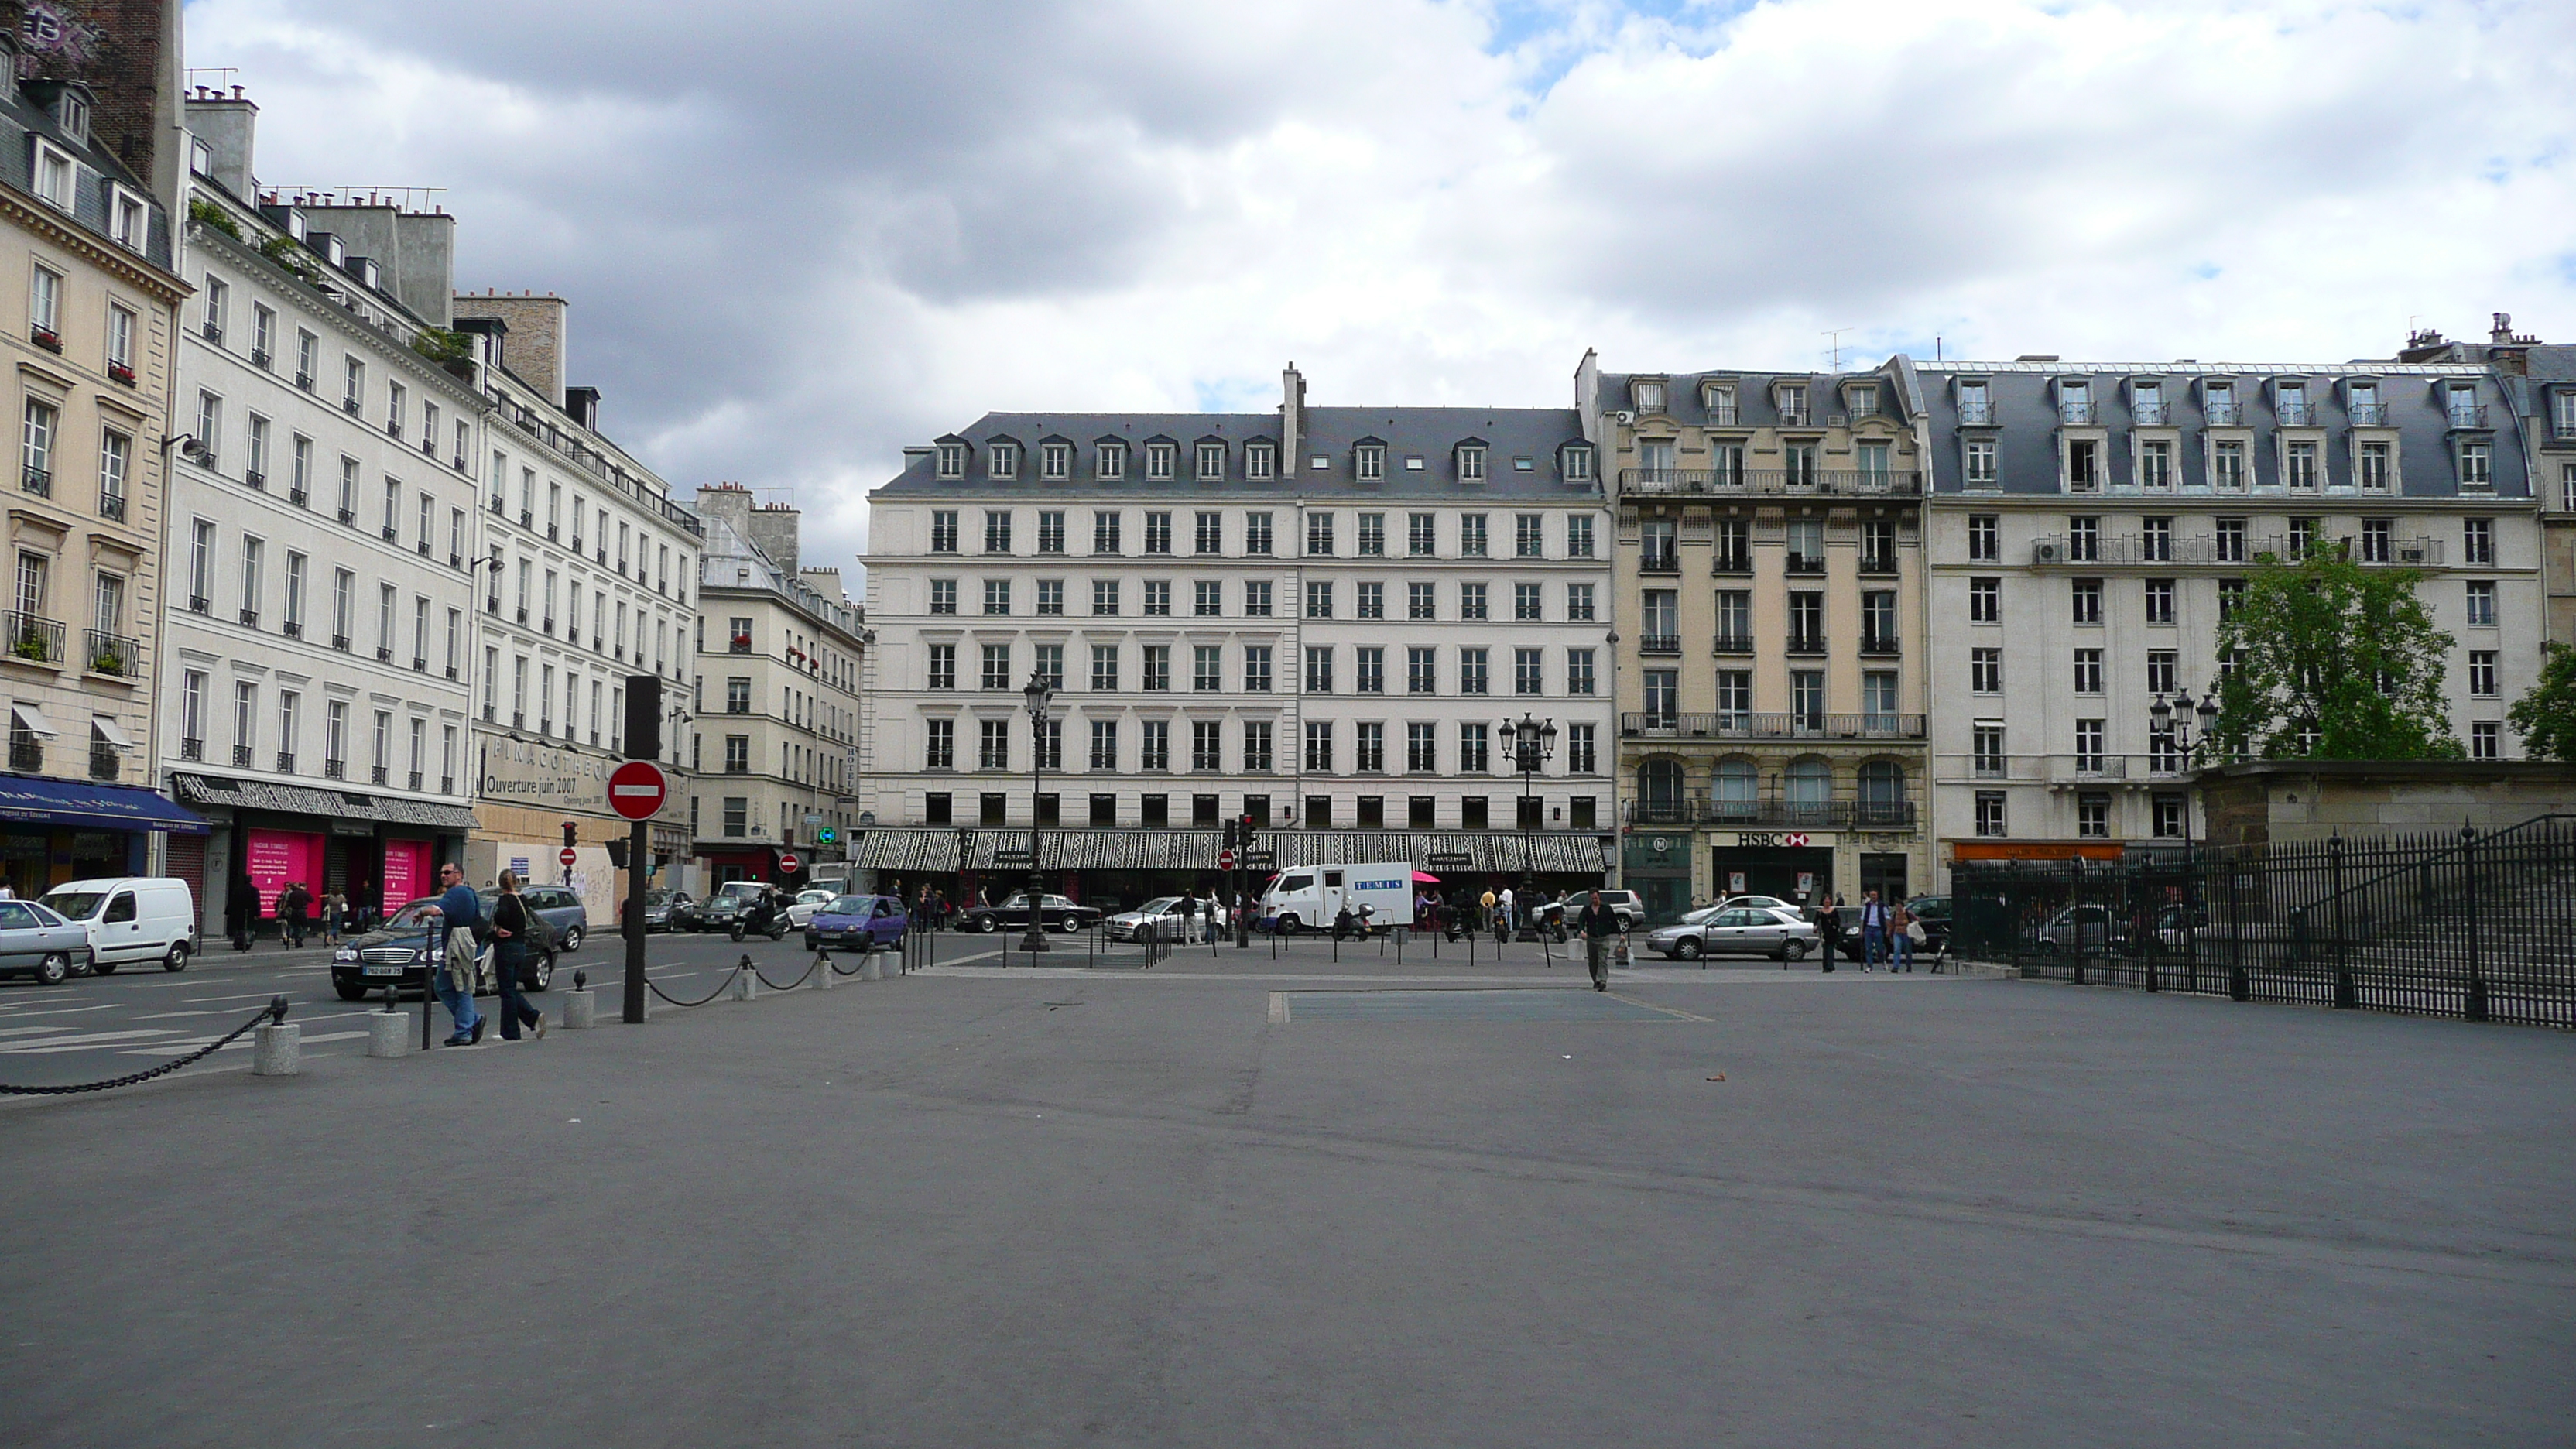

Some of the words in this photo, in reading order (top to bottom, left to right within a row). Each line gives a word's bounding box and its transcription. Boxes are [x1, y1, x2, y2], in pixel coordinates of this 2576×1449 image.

[493, 738, 612, 782] PINACOTHÈQU
[487, 775, 536, 793] Ouverture
[538, 776, 554, 798] juin
[557, 777, 576, 793] 2007
[564, 796, 581, 806] Opening
[582, 796, 592, 805] June
[1738, 833, 1782, 847] HSBC
[1355, 880, 1401, 889] TEMIS
